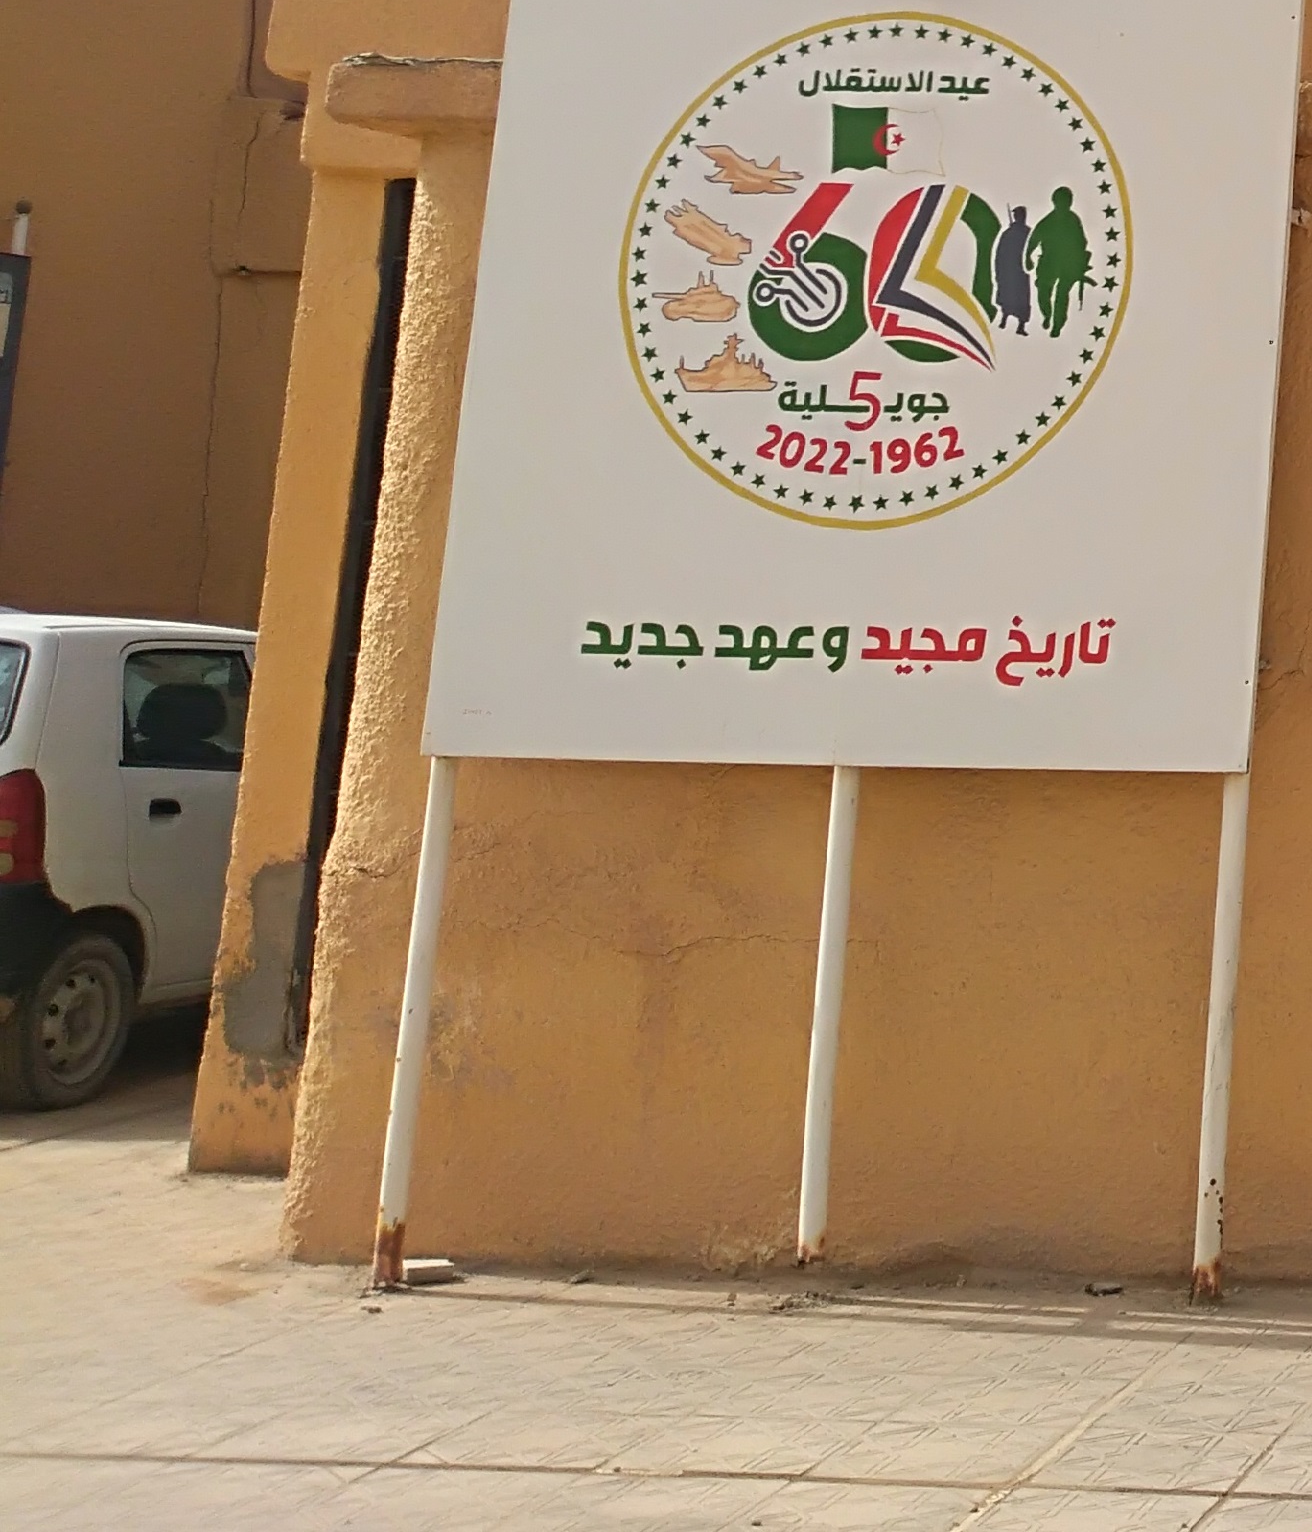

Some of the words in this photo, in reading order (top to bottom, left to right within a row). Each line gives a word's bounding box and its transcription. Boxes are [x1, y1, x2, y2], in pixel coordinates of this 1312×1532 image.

[799, 68, 933, 97] الاستقلال
[938, 76, 990, 101] عيد
[581, 621, 704, 670] جديد
[714, 625, 850, 673] وعهد
[861, 627, 987, 675] مجيد
[996, 616, 1116, 687] تاريخ
